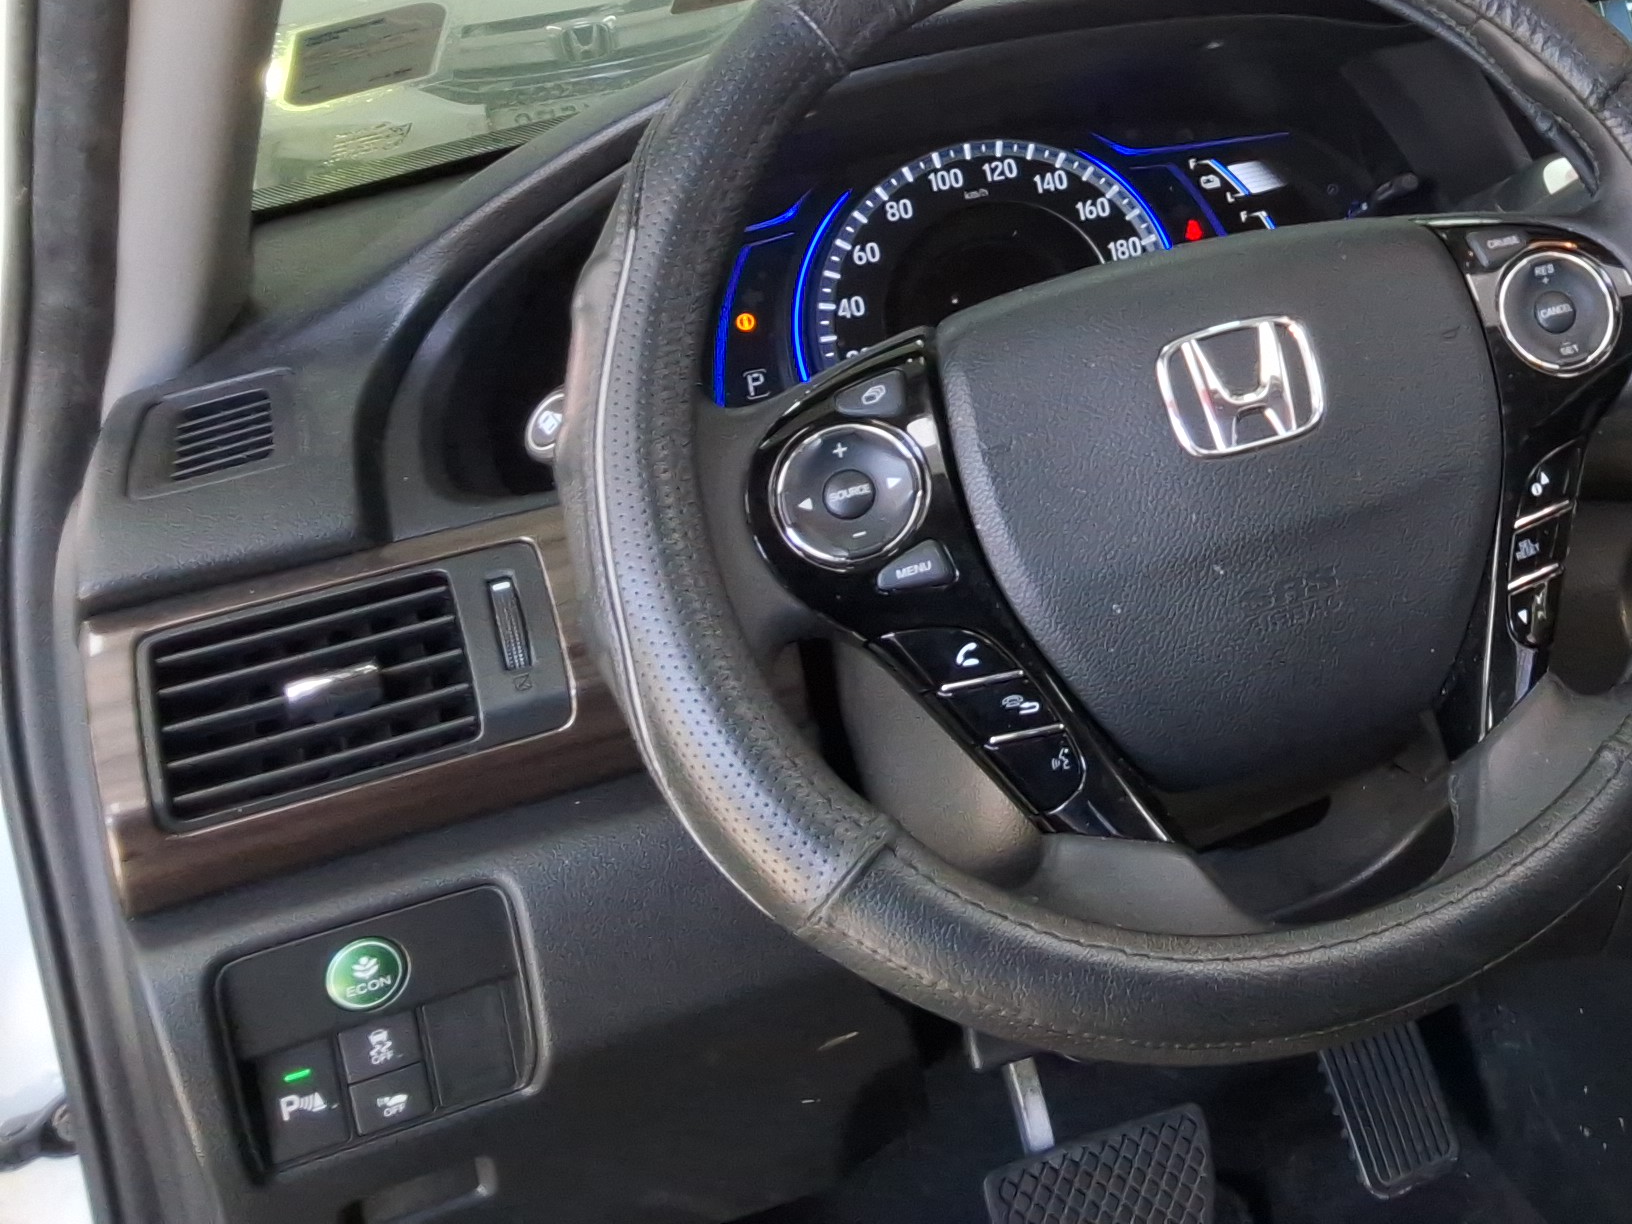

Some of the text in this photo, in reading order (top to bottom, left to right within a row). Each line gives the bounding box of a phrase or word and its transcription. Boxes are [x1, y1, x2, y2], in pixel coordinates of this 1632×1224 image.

[928, 168, 964, 192] 100
[982, 158, 1018, 183] 120
[1033, 170, 1068, 194] 140
[885, 198, 914, 222] 80
[1075, 197, 1111, 221] 160
[853, 242, 881, 265] 60
[1107, 236, 1142, 261] 180
[1534, 263, 1555, 276] RES
[837, 295, 865, 319] 40
[1540, 303, 1574, 318] CANCEL
[746, 373, 765, 396] P
[829, 483, 872, 502] SOURCE
[895, 560, 932, 579] MENU
[345, 974, 392, 998] ECON
[371, 1049, 394, 1066] OFF
[383, 1104, 406, 1118] OFF
